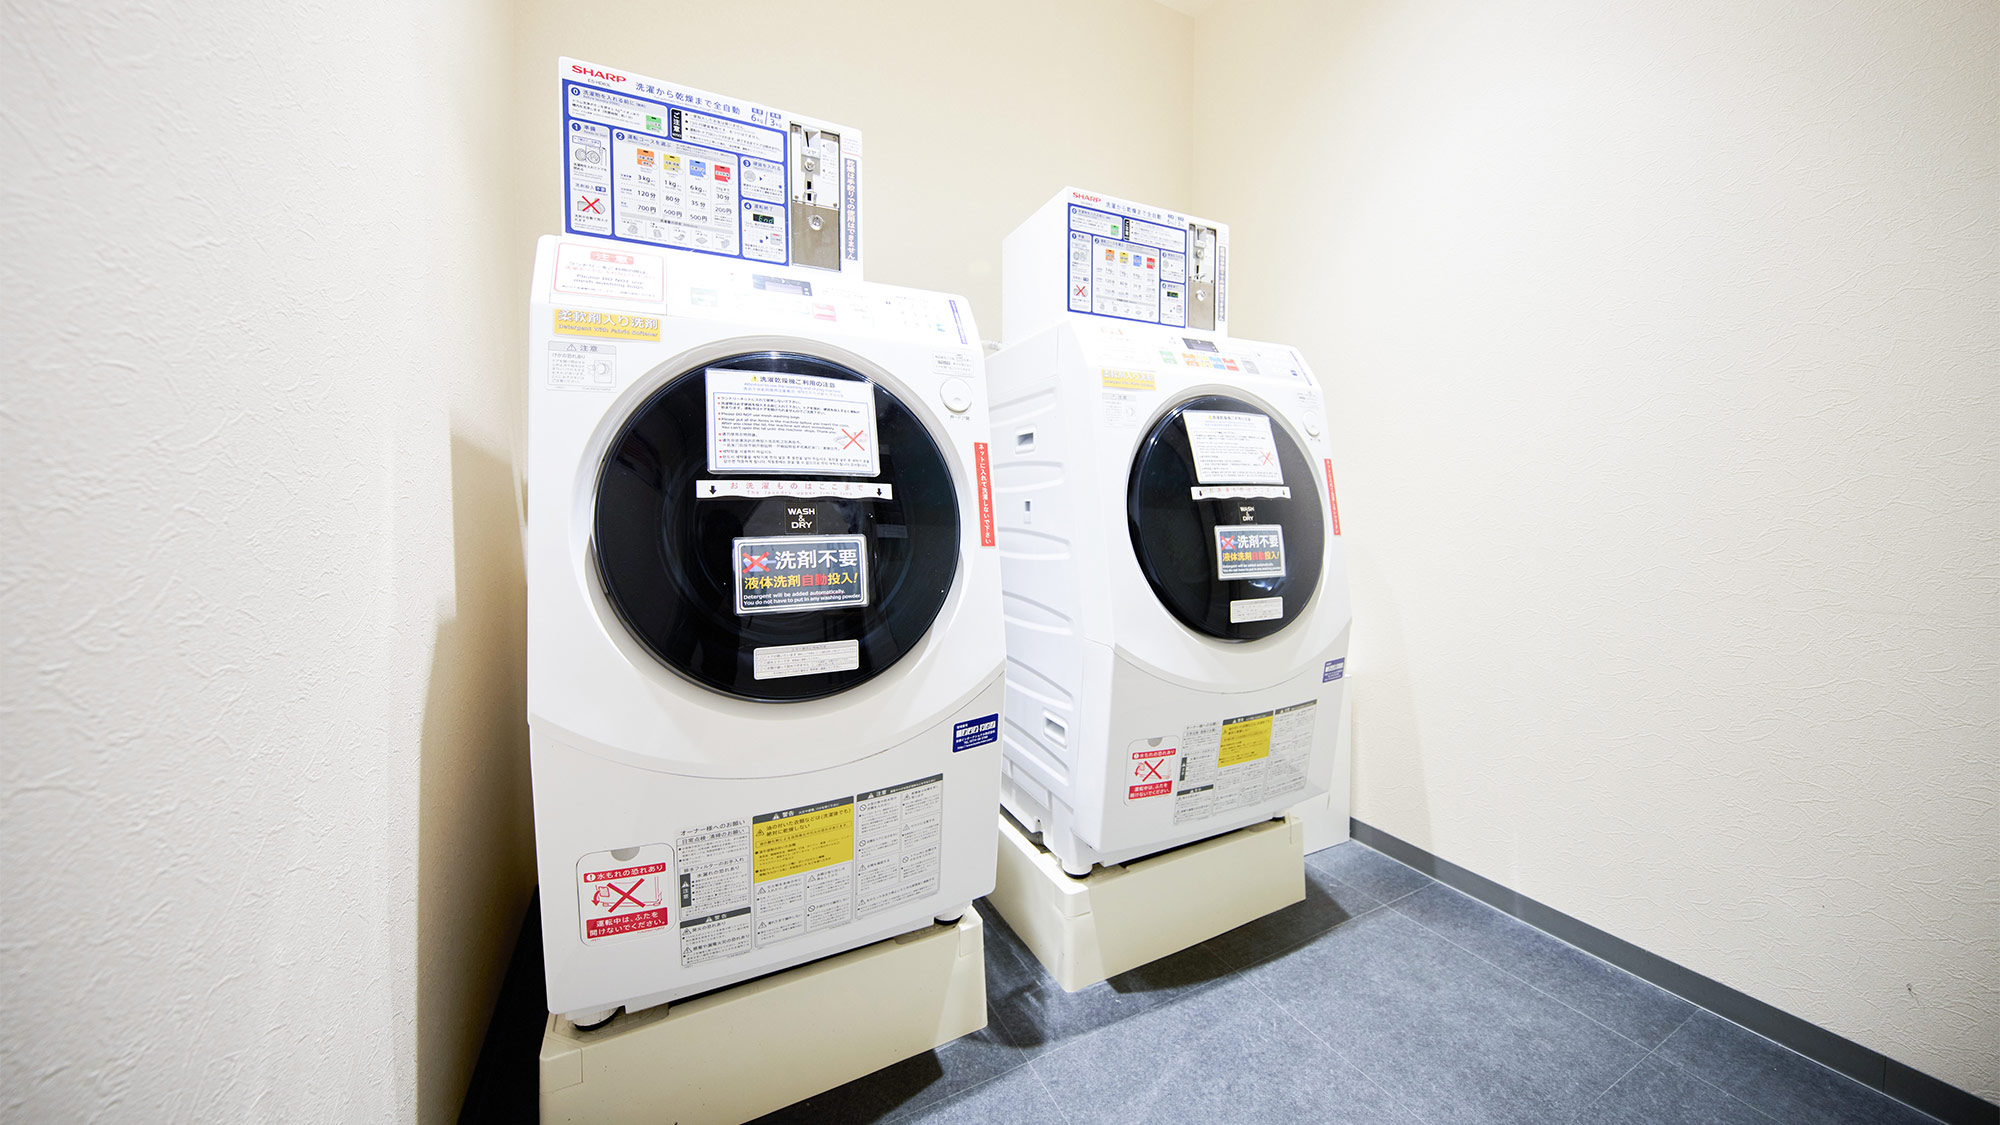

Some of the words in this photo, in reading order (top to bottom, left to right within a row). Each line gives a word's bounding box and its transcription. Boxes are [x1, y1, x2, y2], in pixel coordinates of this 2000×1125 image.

[571, 65, 627, 83] SHARP
[636, 83, 742, 116] 洗濯から乾燥まで全自動
[1072, 191, 1102, 203] SHARP
[638, 204, 657, 214] 700円
[663, 209, 682, 218] 600円
[690, 213, 708, 223] 500円
[557, 311, 659, 330] 柔軟剤入り洗剤
[558, 323, 592, 333] Detergent
[632, 330, 659, 338] Softener
[579, 345, 598, 353] 注意
[787, 507, 816, 517] WASH
[799, 514, 805, 523] &
[791, 521, 813, 530] DRY
[1237, 534, 1280, 550] 洗剤不要
[775, 549, 859, 571] 洗剤不要
[745, 572, 859, 591] 液体洗剤自動投入!
[743, 593, 772, 601] Detergent
[810, 588, 846, 597] automatically.
[794, 597, 804, 605] put
[811, 596, 820, 604] any
[820, 594, 842, 603] washing
[842, 593, 861, 602] powder.
[680, 819, 746, 837] オーナー様へのお願い
[597, 864, 664, 880] 水もれの恐れあり
[596, 911, 659, 928] 運転中は、ふたを
[589, 918, 666, 937] 開けないでください。
